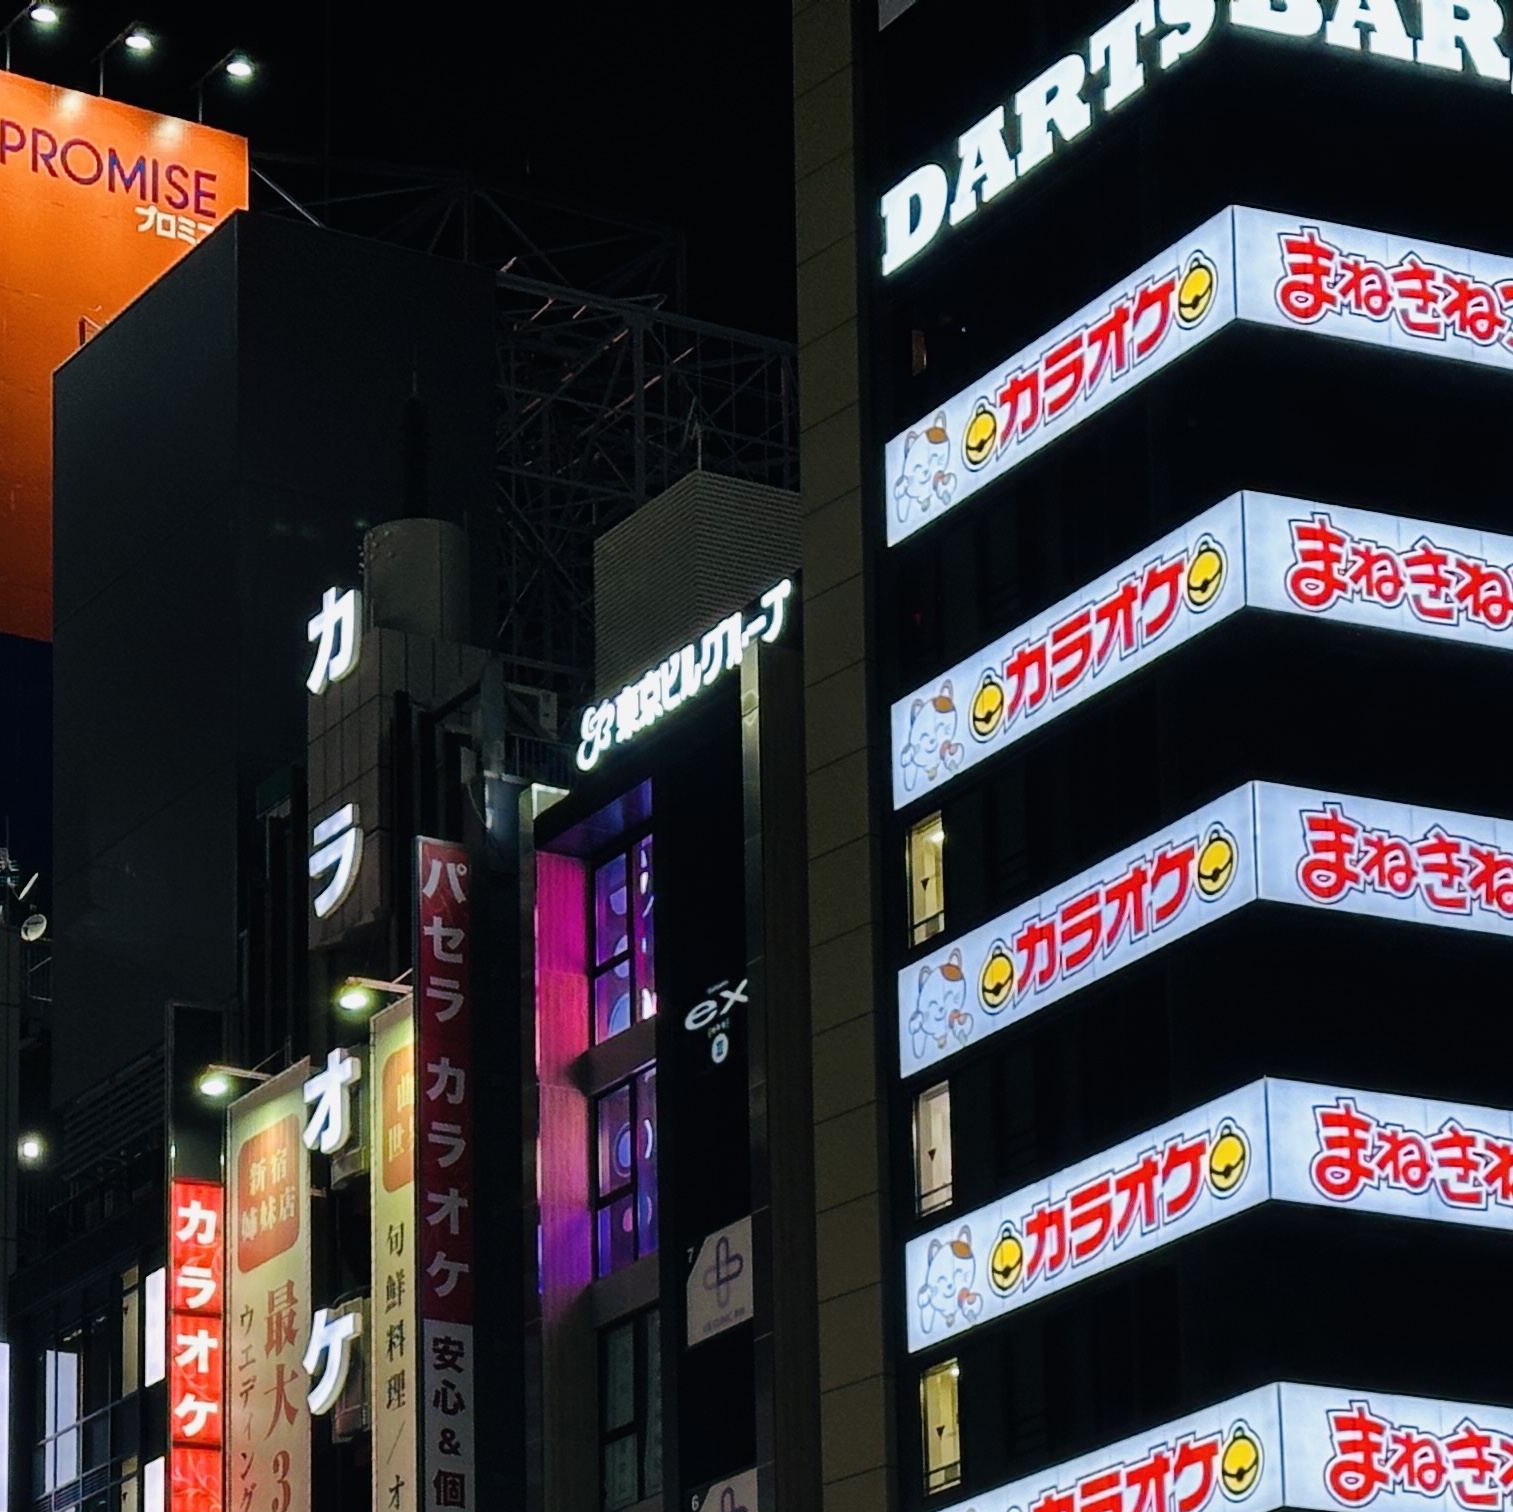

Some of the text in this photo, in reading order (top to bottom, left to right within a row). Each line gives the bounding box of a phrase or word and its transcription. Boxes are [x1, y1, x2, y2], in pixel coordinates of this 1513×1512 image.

[996, 273, 1178, 445] カラオケ
[1278, 230, 1513, 350] まねきね
[1004, 558, 1186, 716] カラオケ
[1014, 845, 1197, 991] カラオケ
[248, 1147, 289, 1194] 新宿
[1024, 1139, 1208, 1277] カラオケ
[174, 1200, 219, 1437] カラオケ
[1328, 1405, 1513, 1508] まねき
